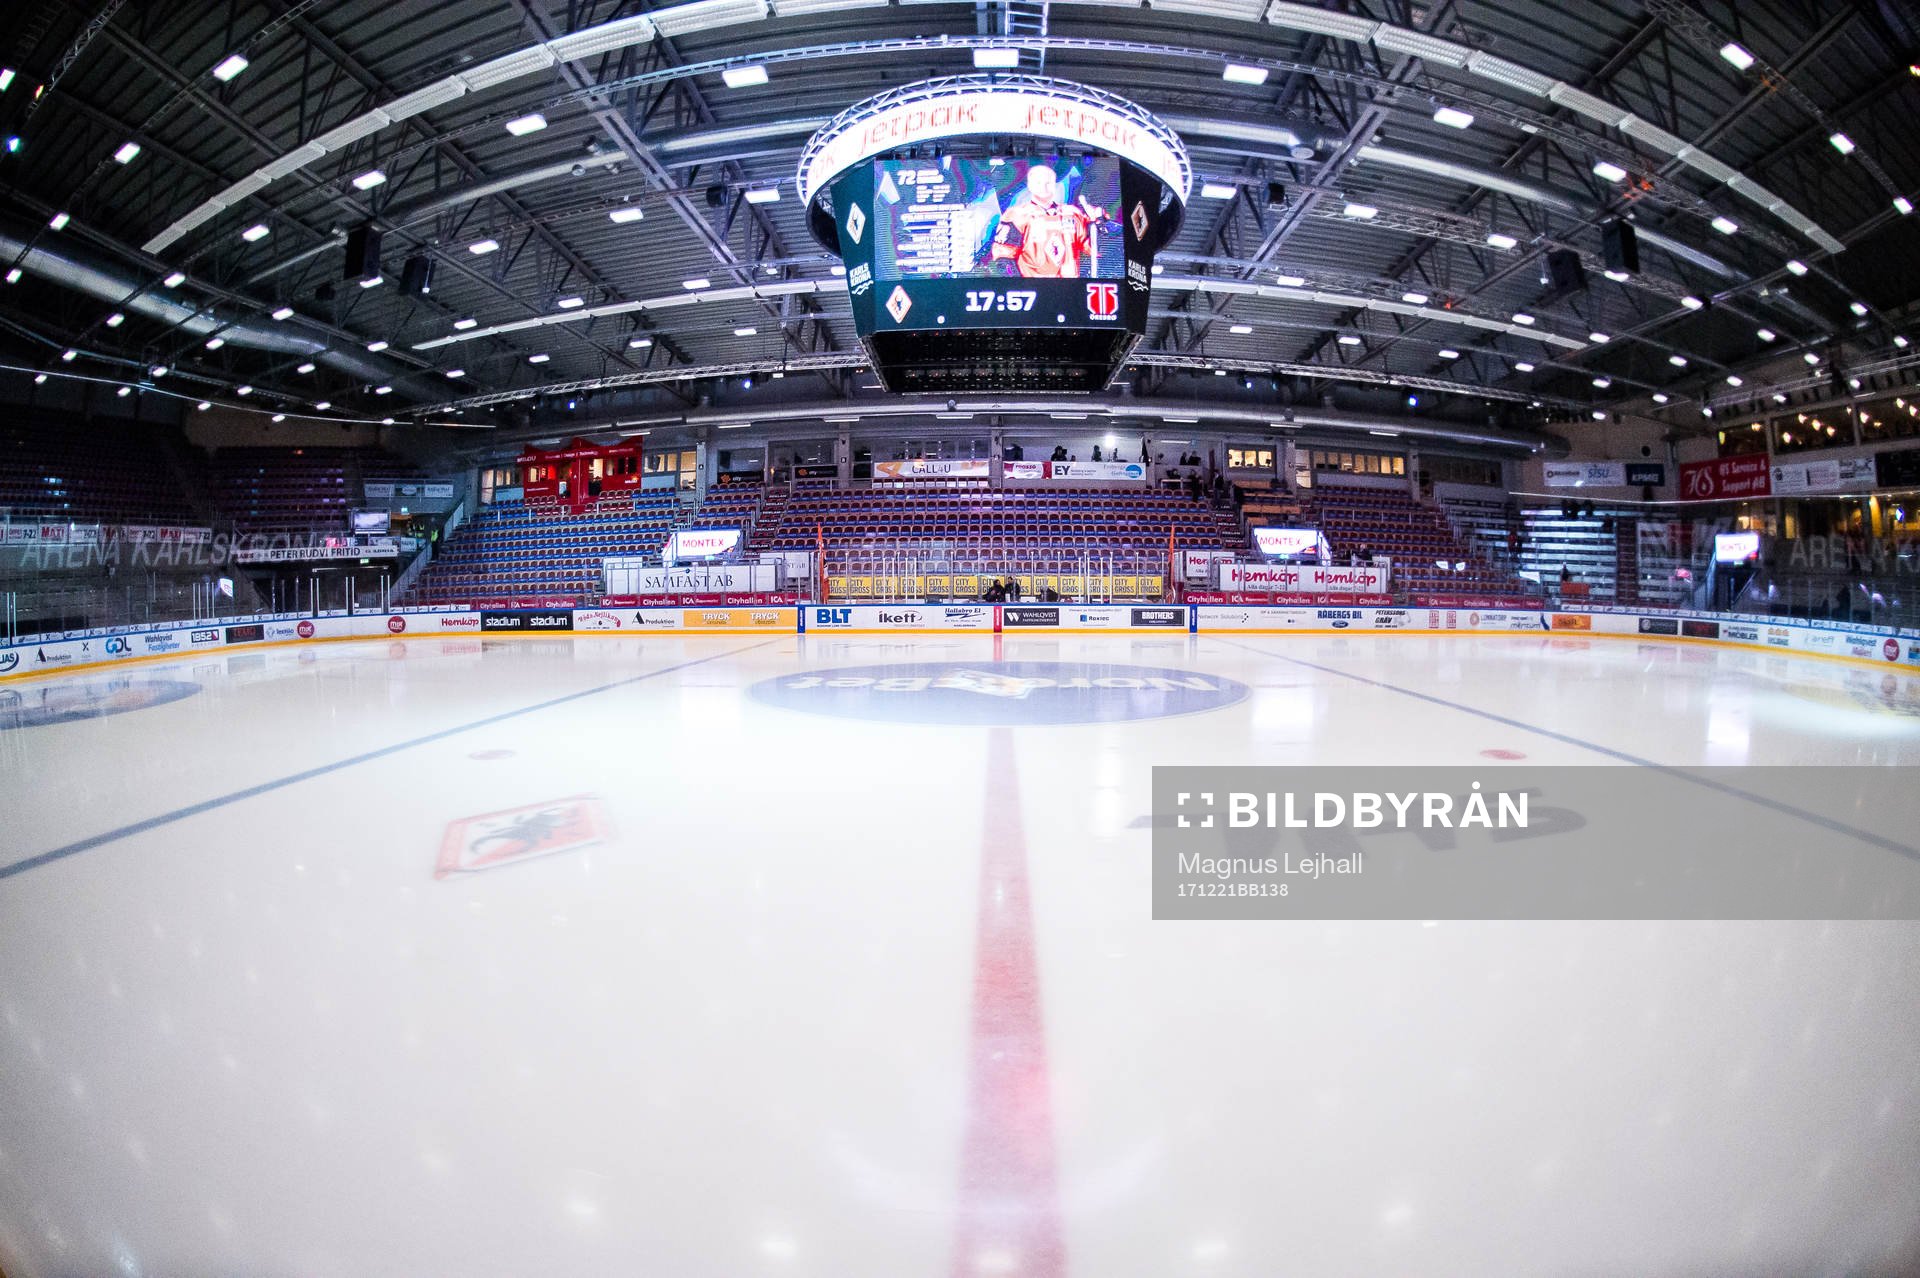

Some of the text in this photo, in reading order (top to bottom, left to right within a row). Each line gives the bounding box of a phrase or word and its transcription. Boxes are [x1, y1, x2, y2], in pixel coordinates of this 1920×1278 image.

[897, 170, 916, 186] 72
[850, 262, 868, 278] KARLS
[1128, 260, 1146, 274] KARLS
[851, 270, 872, 288] KRONA
[1128, 267, 1148, 283] KRONA
[966, 291, 1036, 312] 17:57
[912, 464, 951, 475] CALL4U
[1054, 466, 1070, 476] EY
[682, 538, 724, 548] MONTEX
[1260, 537, 1302, 546] MONTEX
[20, 532, 121, 568] ARENA
[270, 550, 298, 559] PETER
[331, 547, 360, 557] FRITID
[645, 575, 734, 588] SAMFAST AB
[1232, 568, 1298, 586] Hemköp
[1187, 596, 1223, 604] Cityhallen
[816, 608, 852, 624] BLT
[1318, 609, 1350, 619] RÅBERGS
[1352, 610, 1362, 619] BIL
[442, 616, 478, 627] Hemköp
[486, 616, 520, 627] stadium
[530, 616, 568, 626] stadium
[145, 632, 172, 643] Wahlqvist
[106, 636, 132, 654] GDL
